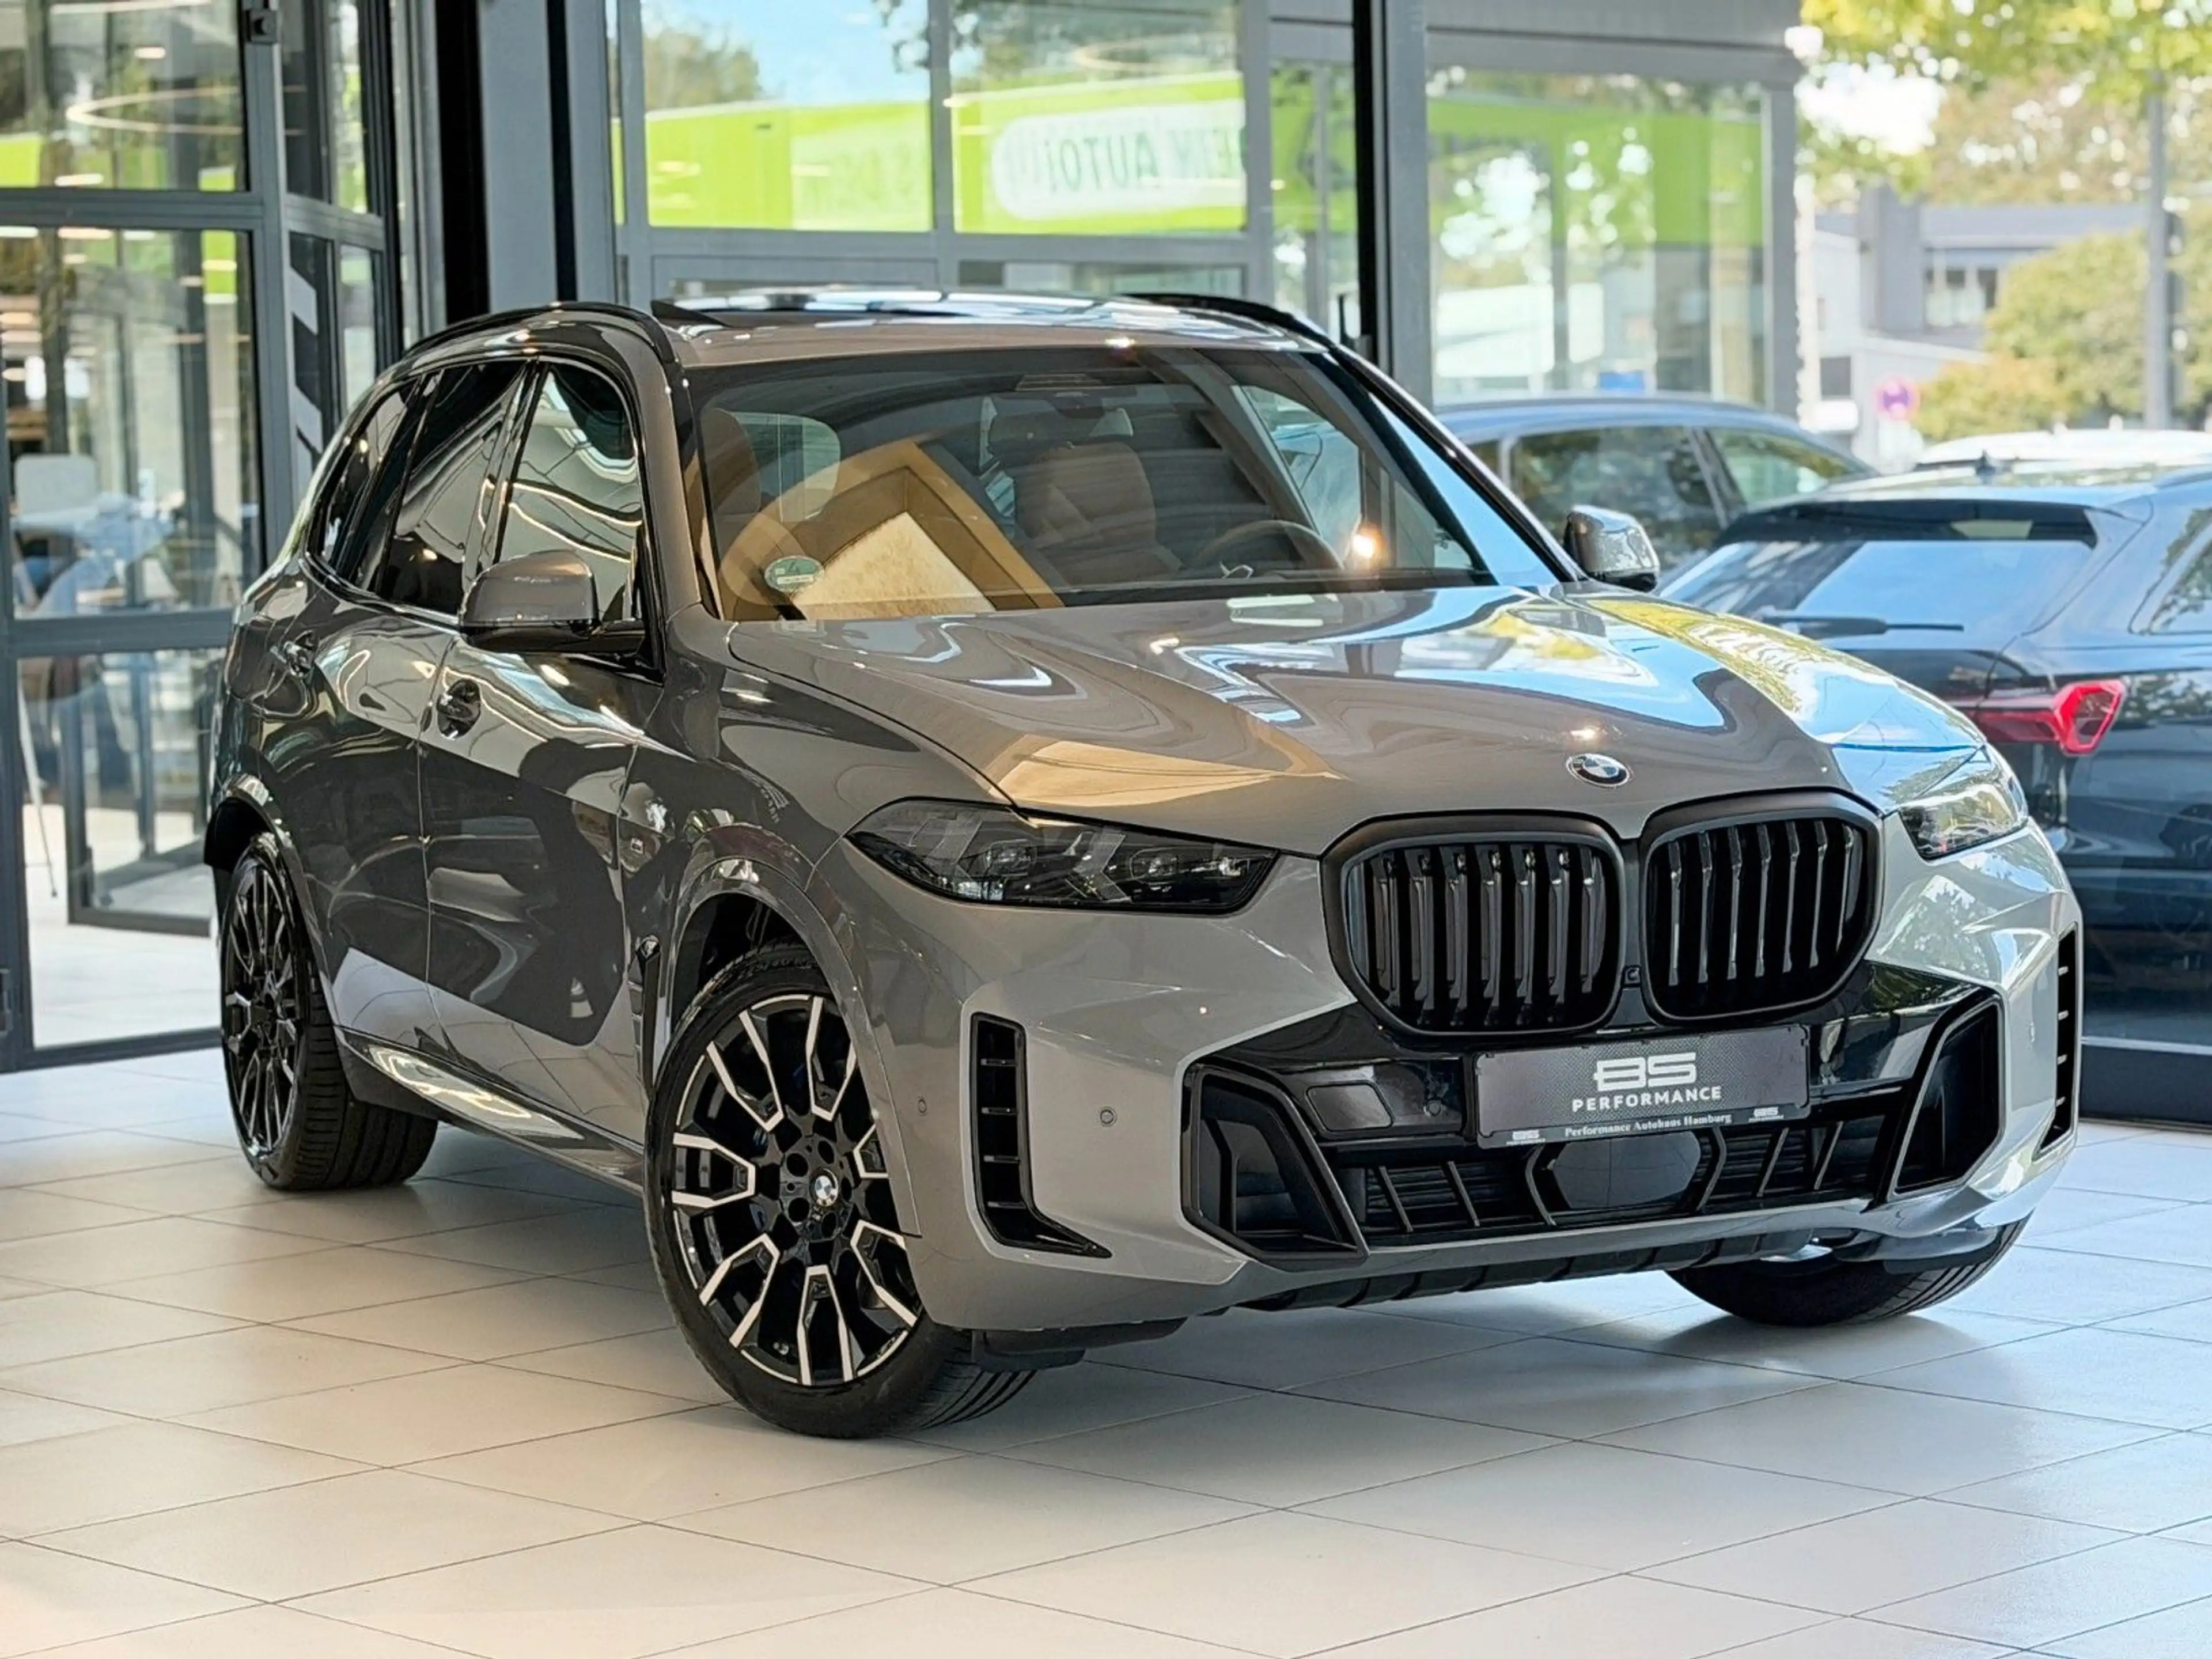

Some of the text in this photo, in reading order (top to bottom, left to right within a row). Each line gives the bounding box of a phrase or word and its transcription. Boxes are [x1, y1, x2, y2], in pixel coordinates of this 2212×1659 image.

[1571, 1085, 1722, 1113] PERFORMANCE
[1565, 1113, 1732, 1138] Performance Autohaus Hamburg
